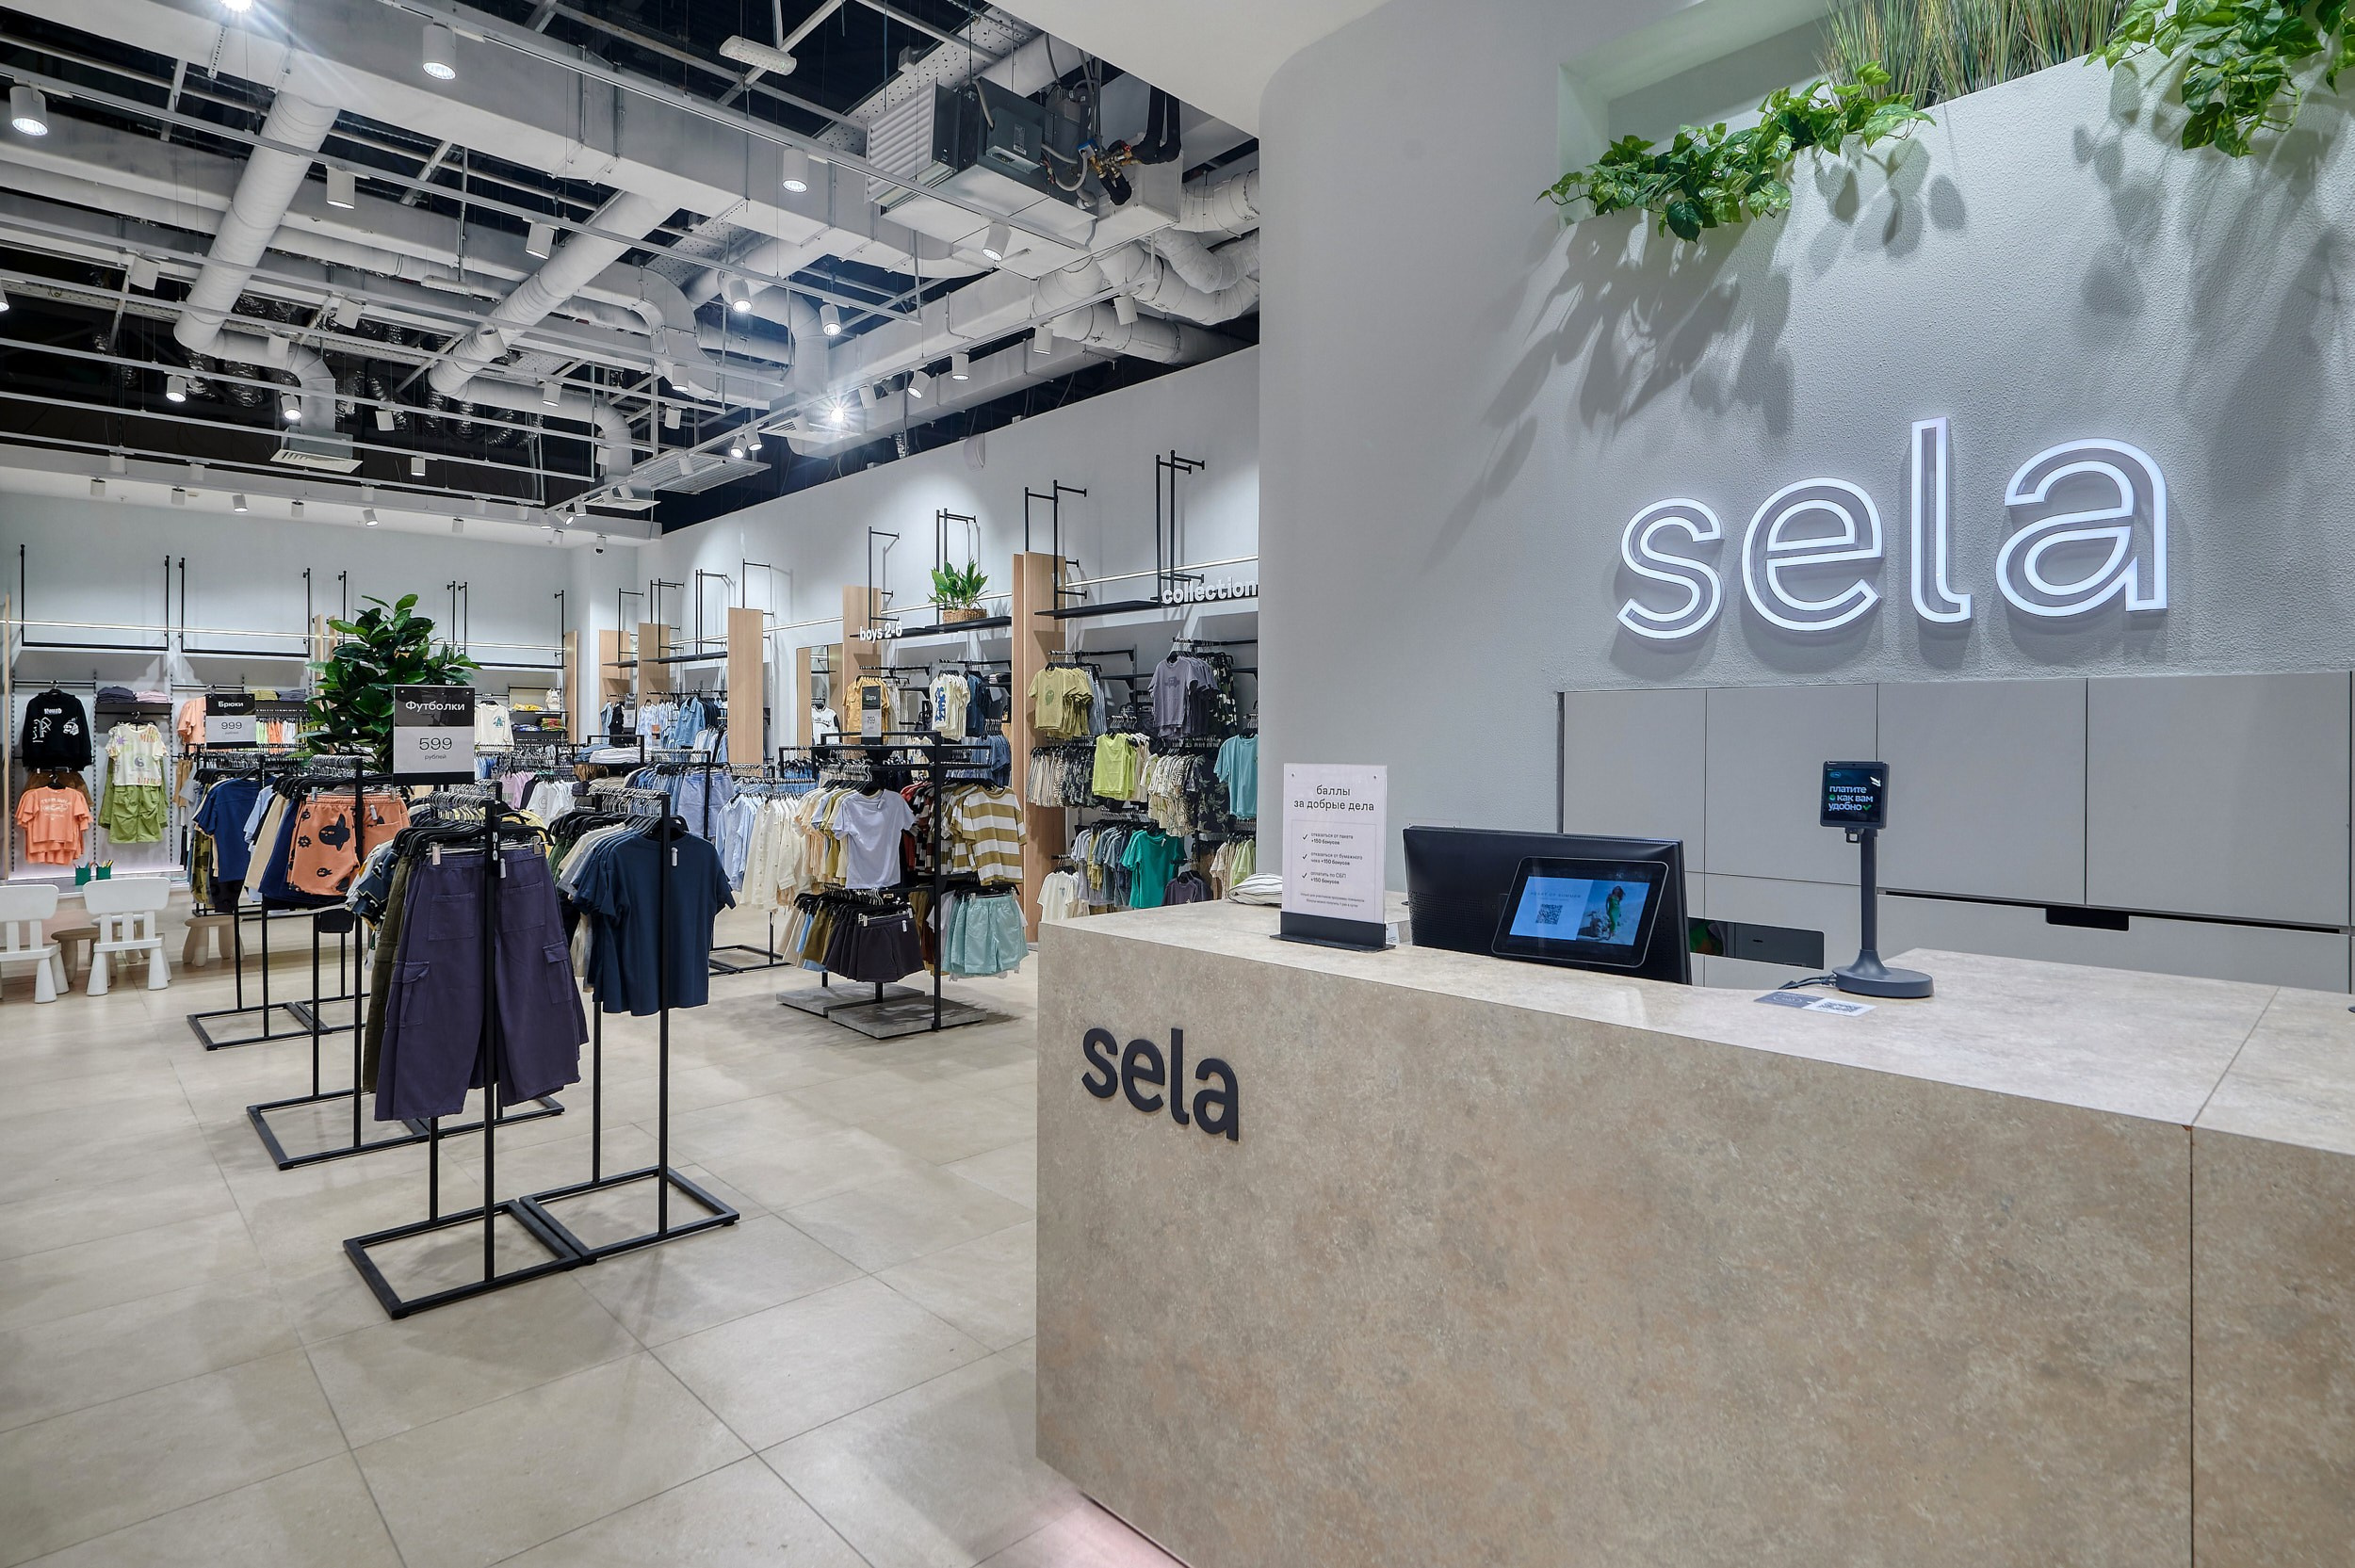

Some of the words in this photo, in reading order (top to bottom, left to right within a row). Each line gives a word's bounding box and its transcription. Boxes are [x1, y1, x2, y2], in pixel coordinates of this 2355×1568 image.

[1616, 415, 2168, 640] sela
[1161, 577, 1257, 605] collection
[859, 625, 883, 643] boys
[884, 621, 903, 639] 2-6
[405, 701, 465, 712] Футболки
[221, 721, 242, 730] 999
[419, 737, 453, 751] 599
[1316, 784, 1351, 796] баллы
[1293, 800, 1305, 808] за
[1307, 799, 1346, 811] добрые
[1348, 802, 1374, 812] дела
[1827, 801, 1862, 811] удобно
[1081, 1027, 1239, 1141] sela
